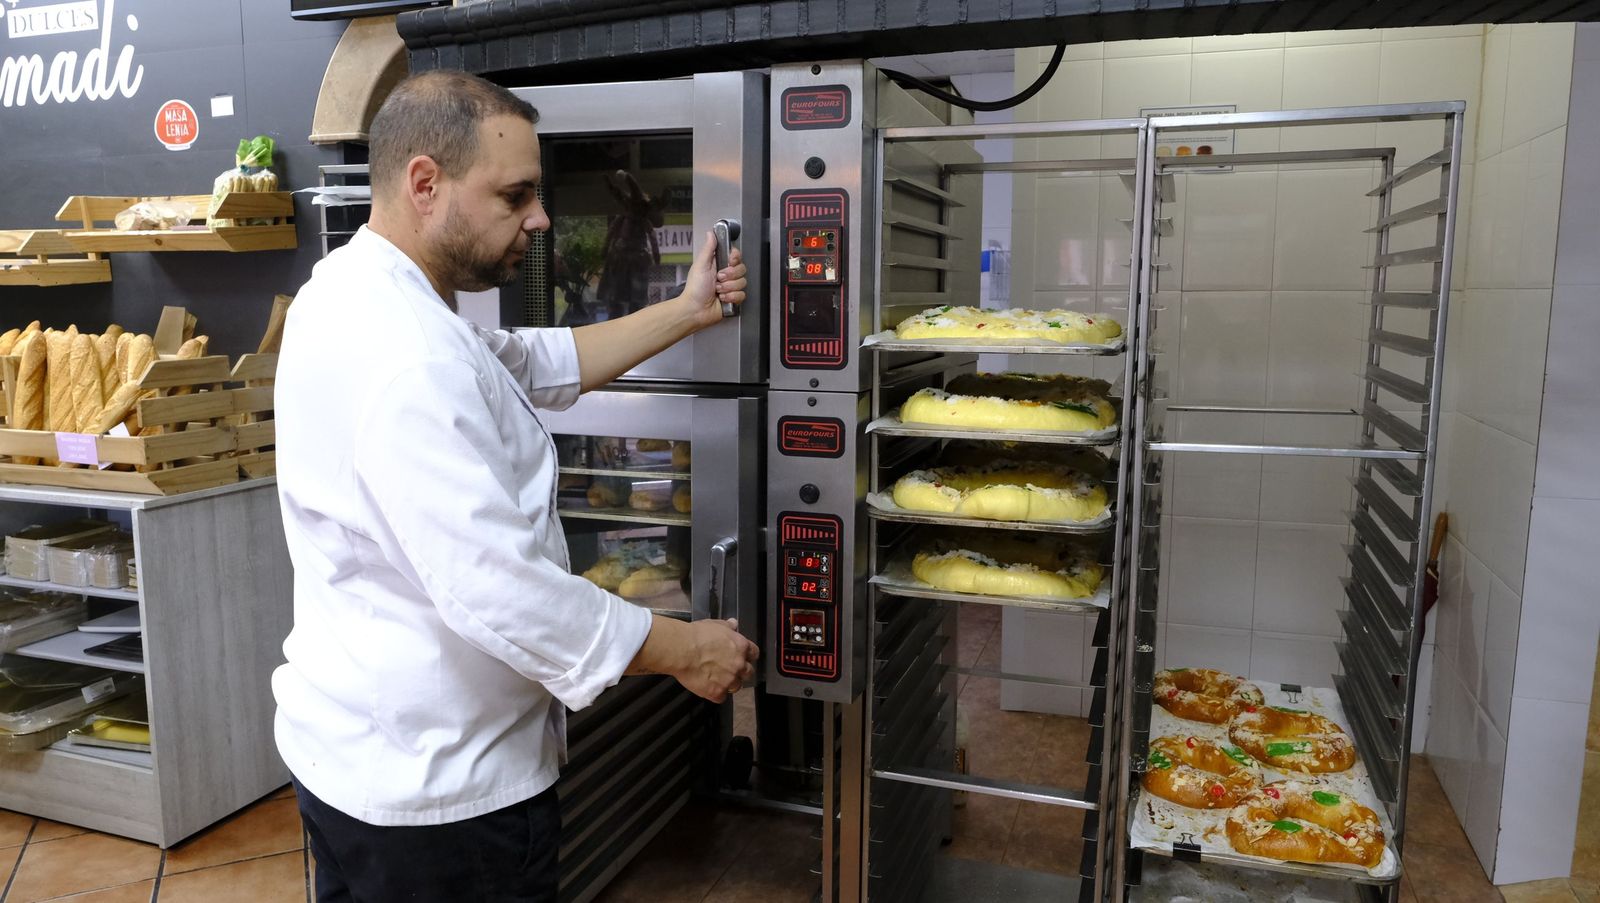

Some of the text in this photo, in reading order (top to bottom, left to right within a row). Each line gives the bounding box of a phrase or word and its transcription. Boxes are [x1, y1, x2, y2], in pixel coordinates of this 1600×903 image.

[13, 9, 94, 33] DULCES
[165, 109, 188, 122] MASA
[810, 237, 818, 247] 6
[807, 263, 822, 273] 08
[806, 557, 813, 567] 8
